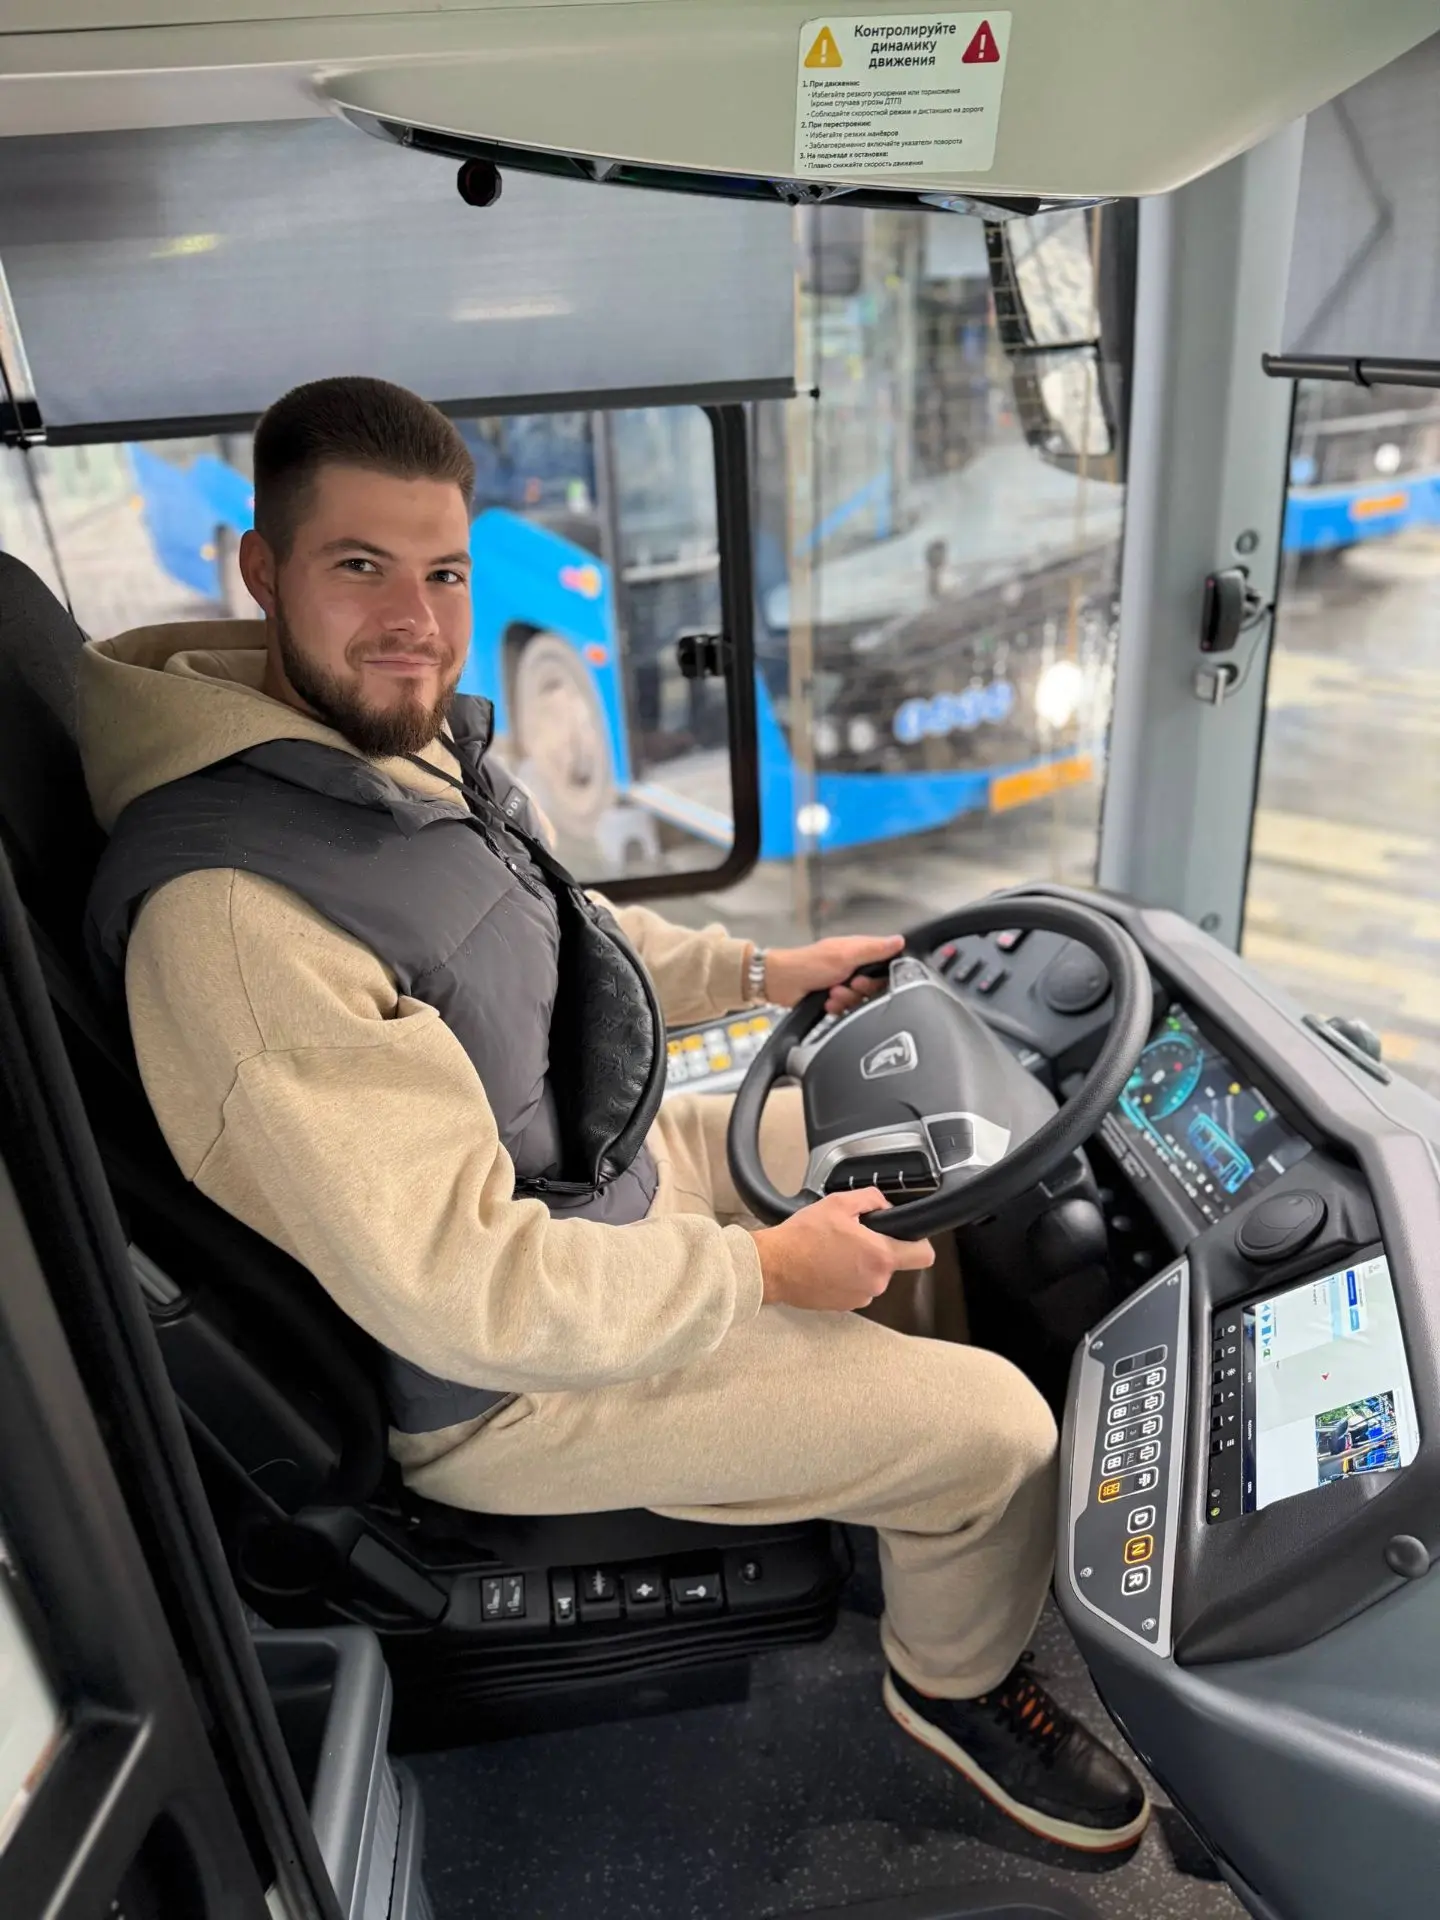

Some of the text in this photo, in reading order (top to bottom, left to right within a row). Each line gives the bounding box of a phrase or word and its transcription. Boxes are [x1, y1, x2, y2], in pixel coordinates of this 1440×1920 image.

[854, 22, 957, 39] Контролируйте
[870, 40, 937, 54] динамику
[868, 56, 936, 69] движения
[809, 80, 824, 89] При
[824, 80, 860, 88] движении:
[846, 90, 872, 99] резкого
[872, 90, 907, 98] ускорения
[921, 88, 961, 96] торможения
[811, 97, 902, 108] (кроме случаев угрозы ДТП)
[810, 110, 850, 118] Соблюдайте
[851, 108, 888, 117] скоростной
[888, 108, 912, 116] режим
[918, 107, 953, 115] дистанцию
[962, 106, 985, 114] дороге
[808, 121, 822, 130] При
[823, 121, 871, 129] перестроении:
[809, 131, 843, 139] Избегайте
[867, 130, 899, 138] манёвров
[808, 142, 866, 150] Заблаговременно
[900, 140, 933, 148] указатели
[933, 138, 963, 146] поворота
[806, 152, 816, 160] На
[853, 151, 889, 159] остановке:
[892, 159, 924, 168] движения
[1126, 1452, 1134, 1466] ALL
[1134, 1512, 1148, 1525] D
[1131, 1542, 1146, 1556] N
[1129, 1572, 1144, 1588] R
